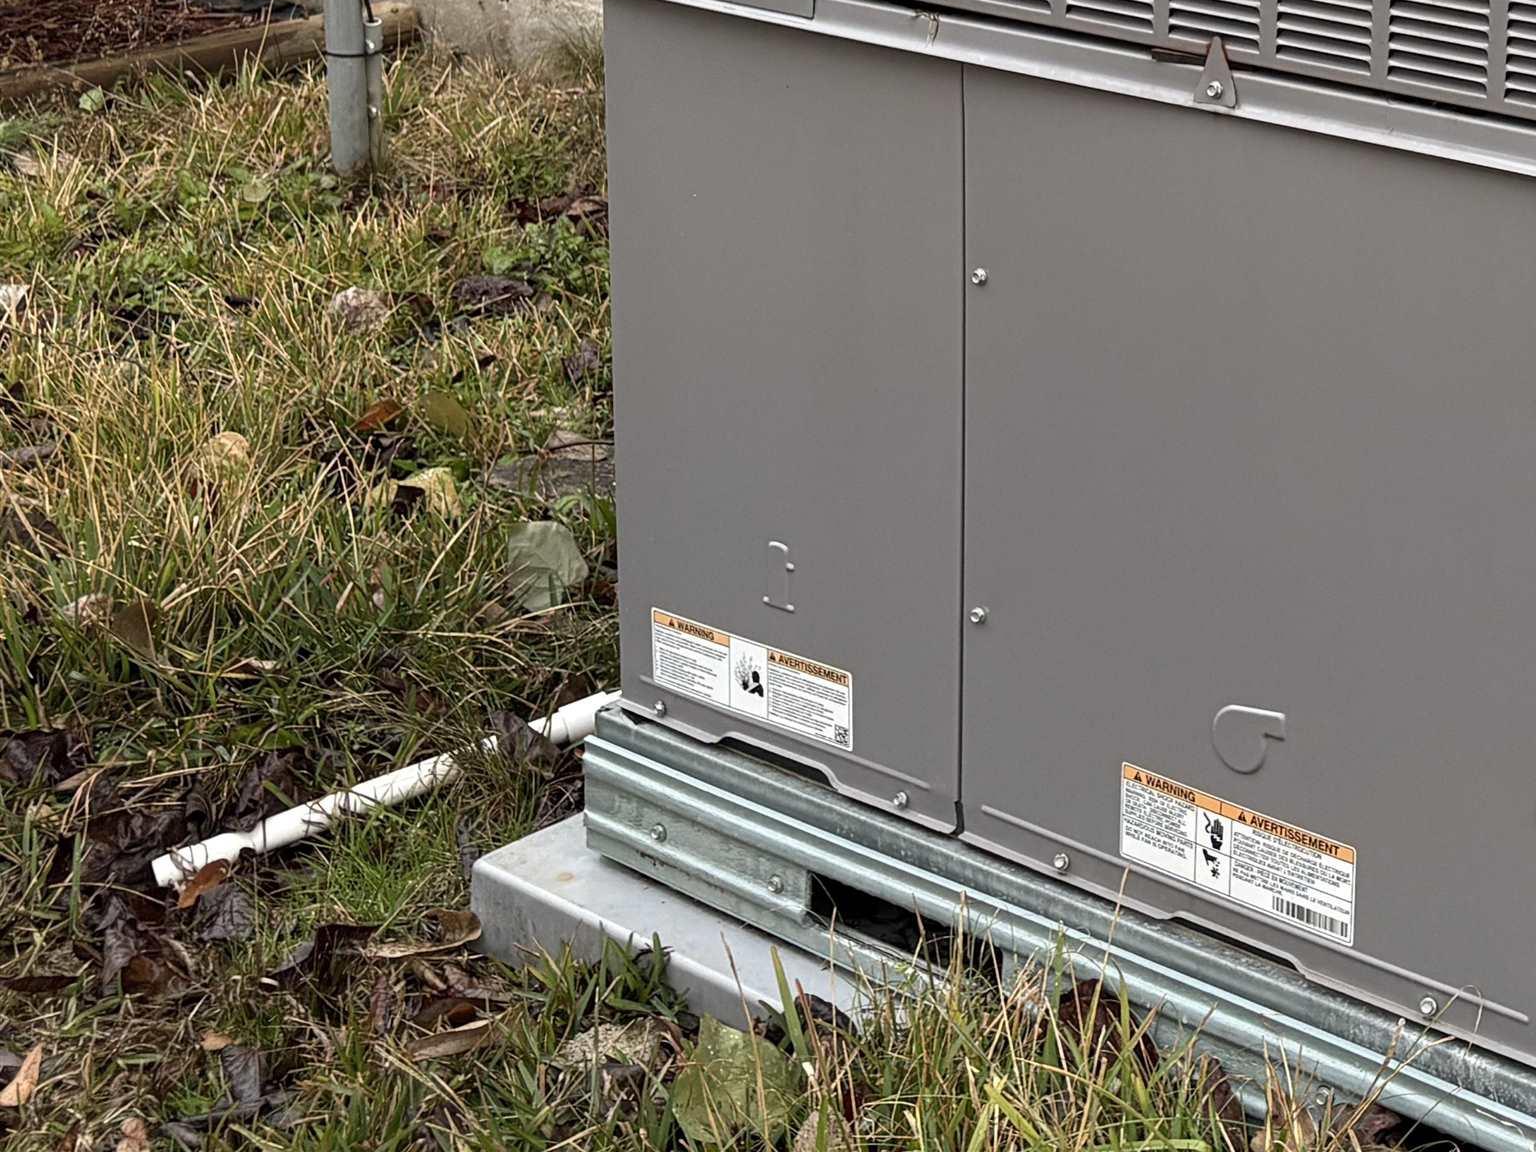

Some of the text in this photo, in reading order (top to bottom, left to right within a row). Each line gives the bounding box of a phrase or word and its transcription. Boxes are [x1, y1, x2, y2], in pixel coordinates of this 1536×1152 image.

[678, 621, 713, 640] WARNING
[778, 654, 846, 684] AVERTISSEMENT
[1145, 775, 1195, 802] WARNING
[1250, 814, 1339, 856] AVERTISSEMENT
